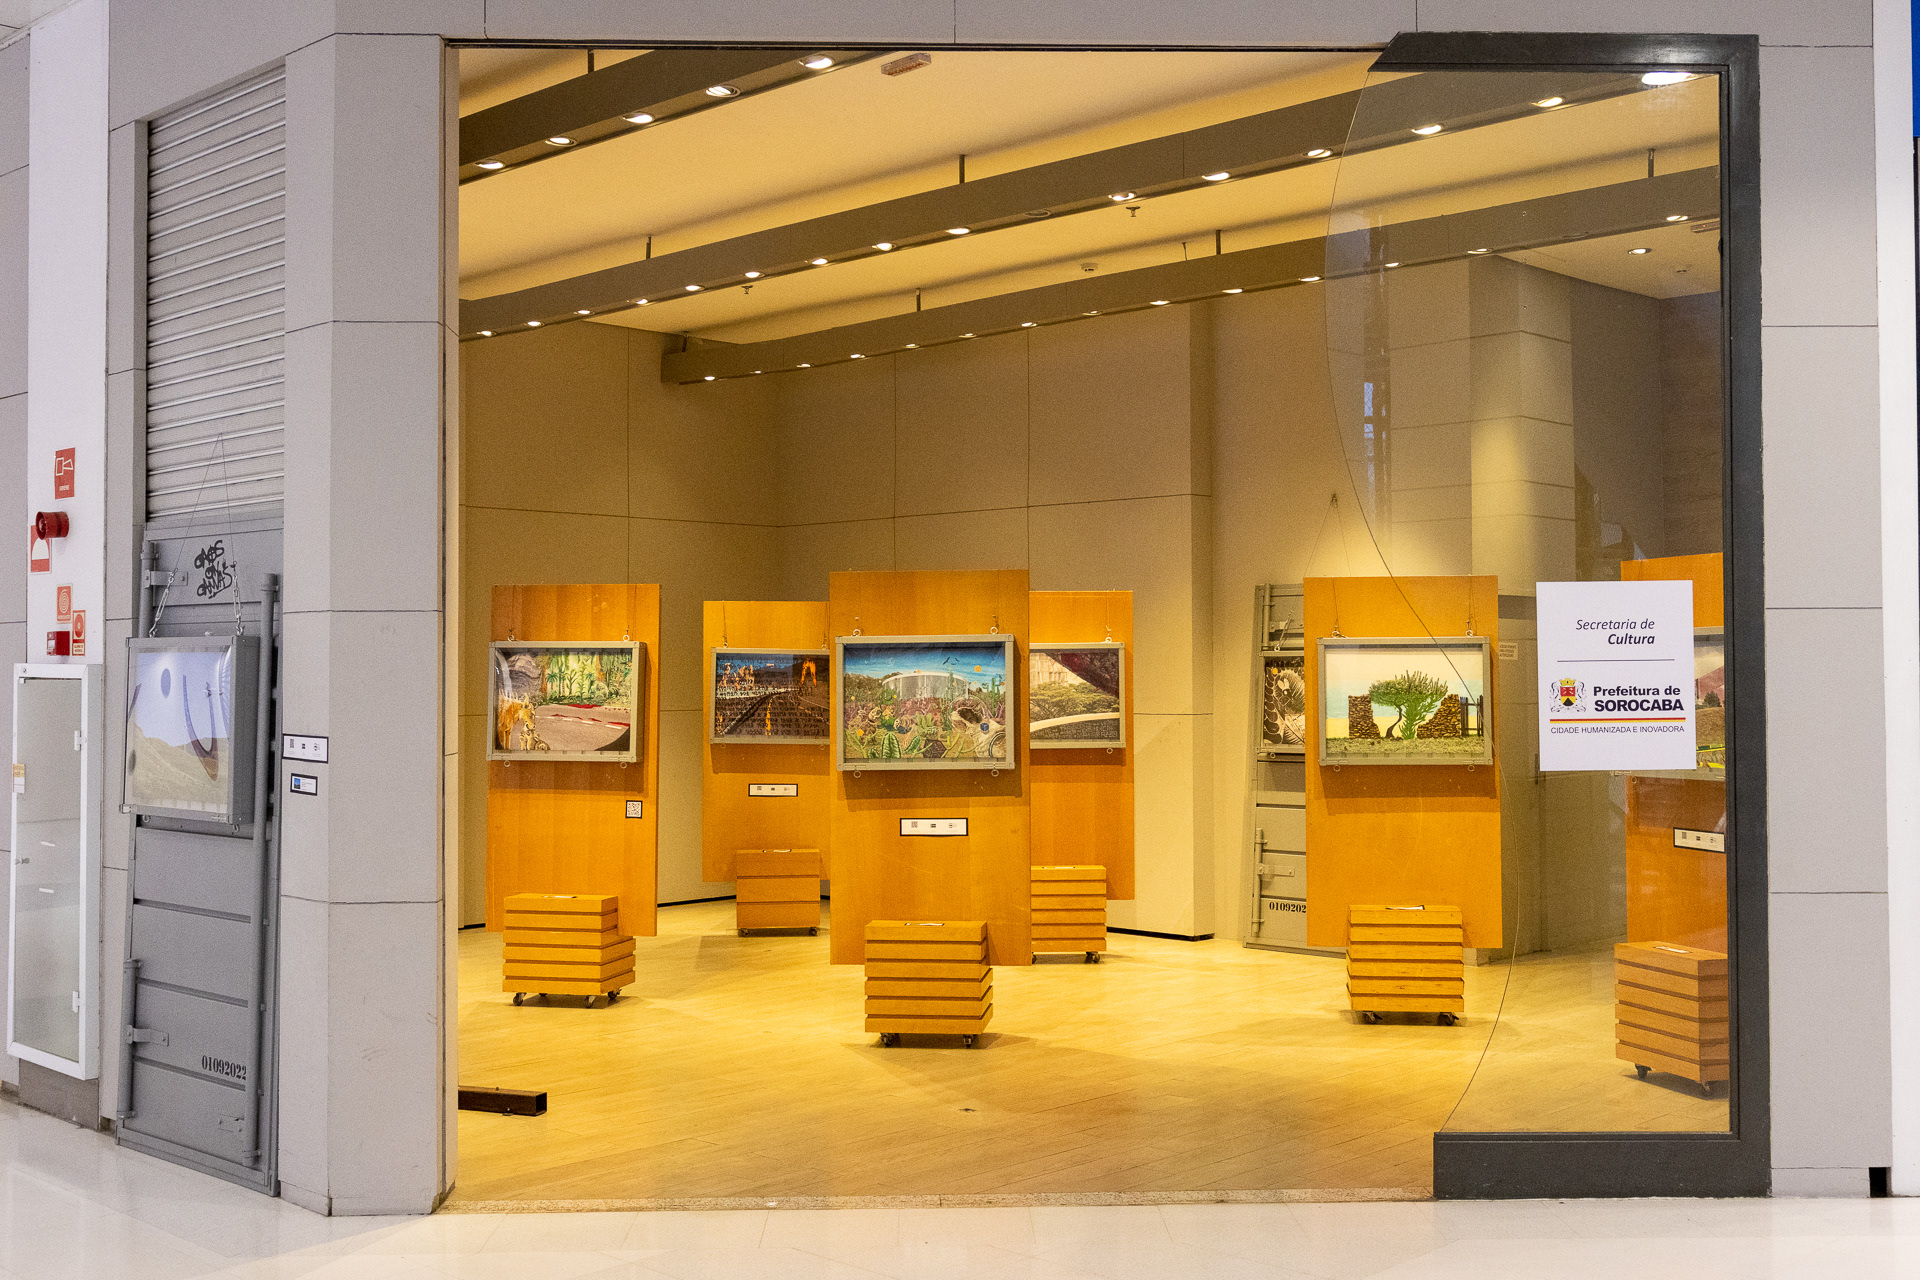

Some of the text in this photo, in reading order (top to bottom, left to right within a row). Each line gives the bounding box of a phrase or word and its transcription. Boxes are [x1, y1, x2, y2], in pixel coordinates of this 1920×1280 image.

[1575, 618, 1655, 630] Secretaria de
[1607, 633, 1655, 645] Cultura
[1593, 685, 1681, 697] Prefeitura de
[1594, 699, 1684, 712] SOROCABA
[1550, 726, 1580, 734] CIDADE
[1581, 726, 1632, 734] HUMANIZADA
[1639, 725, 1685, 733] INOVADORA
[202, 1055, 247, 1080] 01092022
